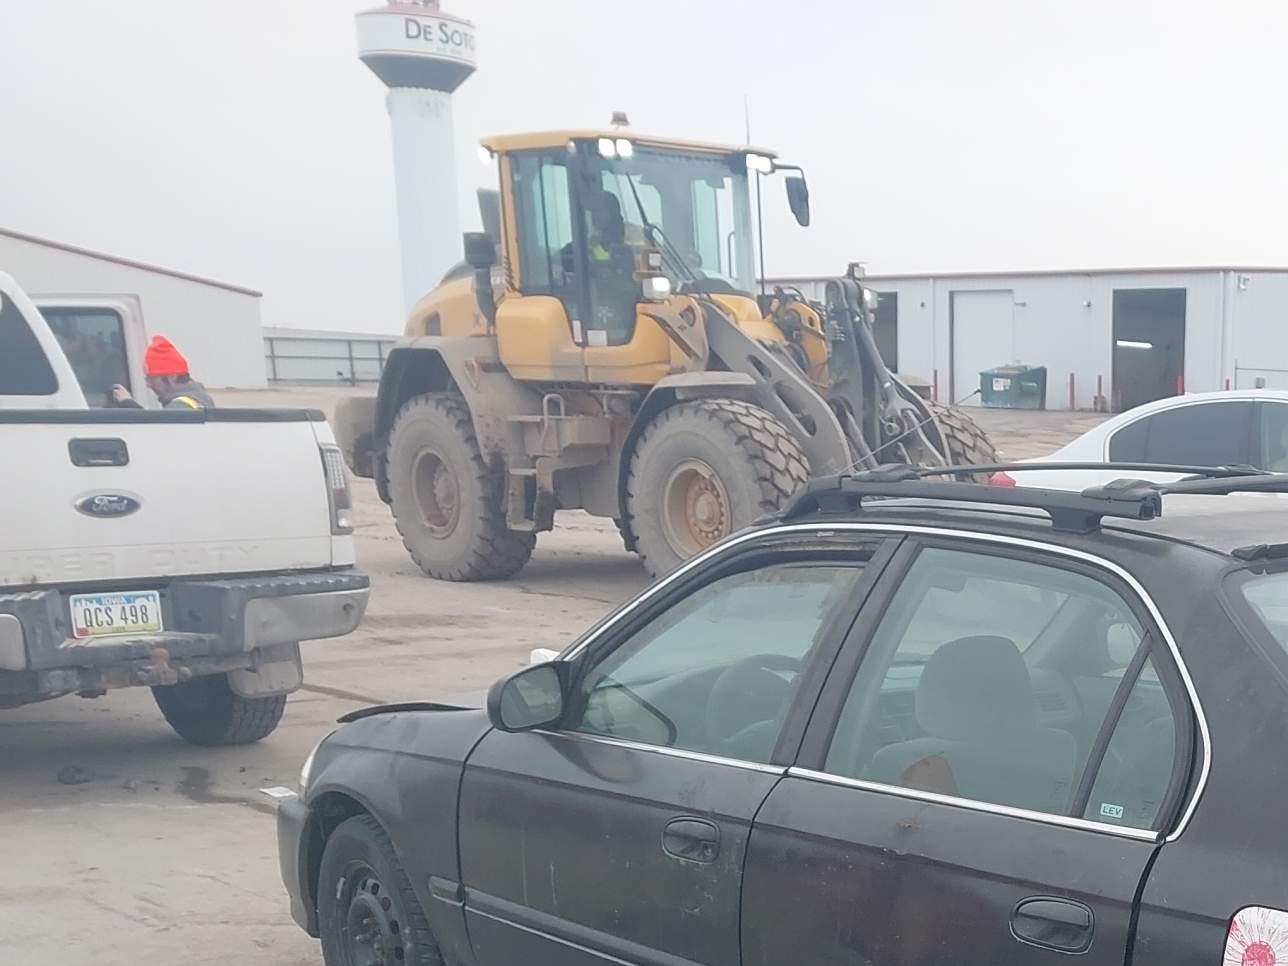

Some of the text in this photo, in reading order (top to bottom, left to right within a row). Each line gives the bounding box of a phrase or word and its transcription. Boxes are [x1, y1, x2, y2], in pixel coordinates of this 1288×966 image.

[83, 604, 149, 628] QCS 498
[1102, 805, 1122, 816] LEV
